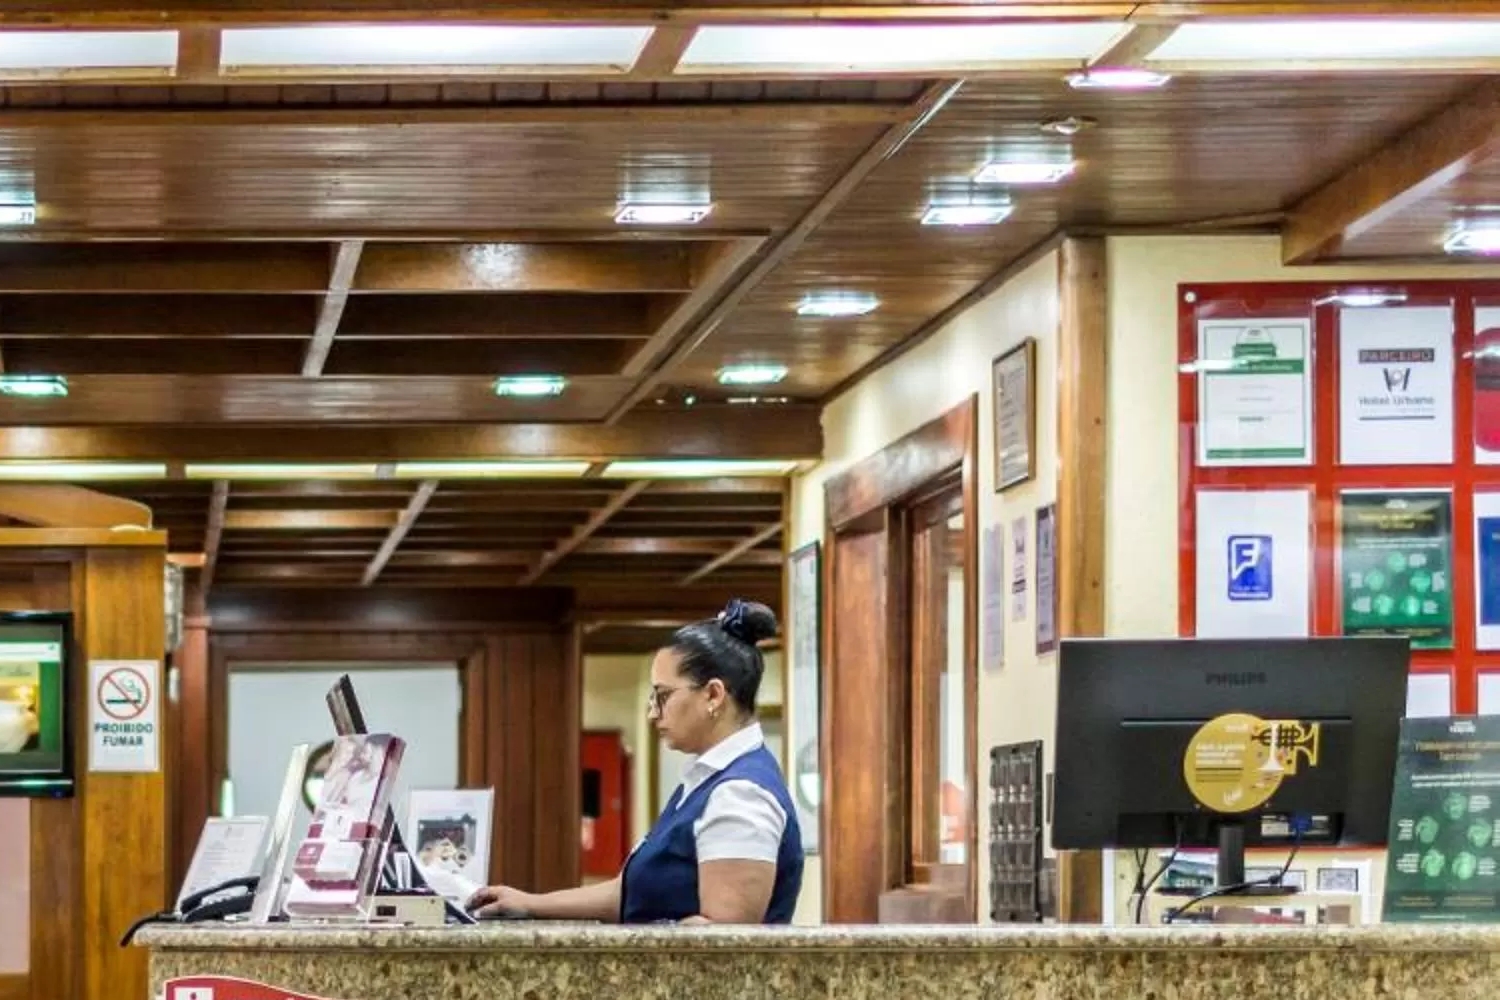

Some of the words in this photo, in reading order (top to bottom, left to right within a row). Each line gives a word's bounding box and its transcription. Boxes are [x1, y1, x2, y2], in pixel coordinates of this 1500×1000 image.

[1205, 672, 1267, 684] PHILIPS
[94, 723, 153, 733] PROIBIDO
[103, 736, 143, 746] FUMAR
